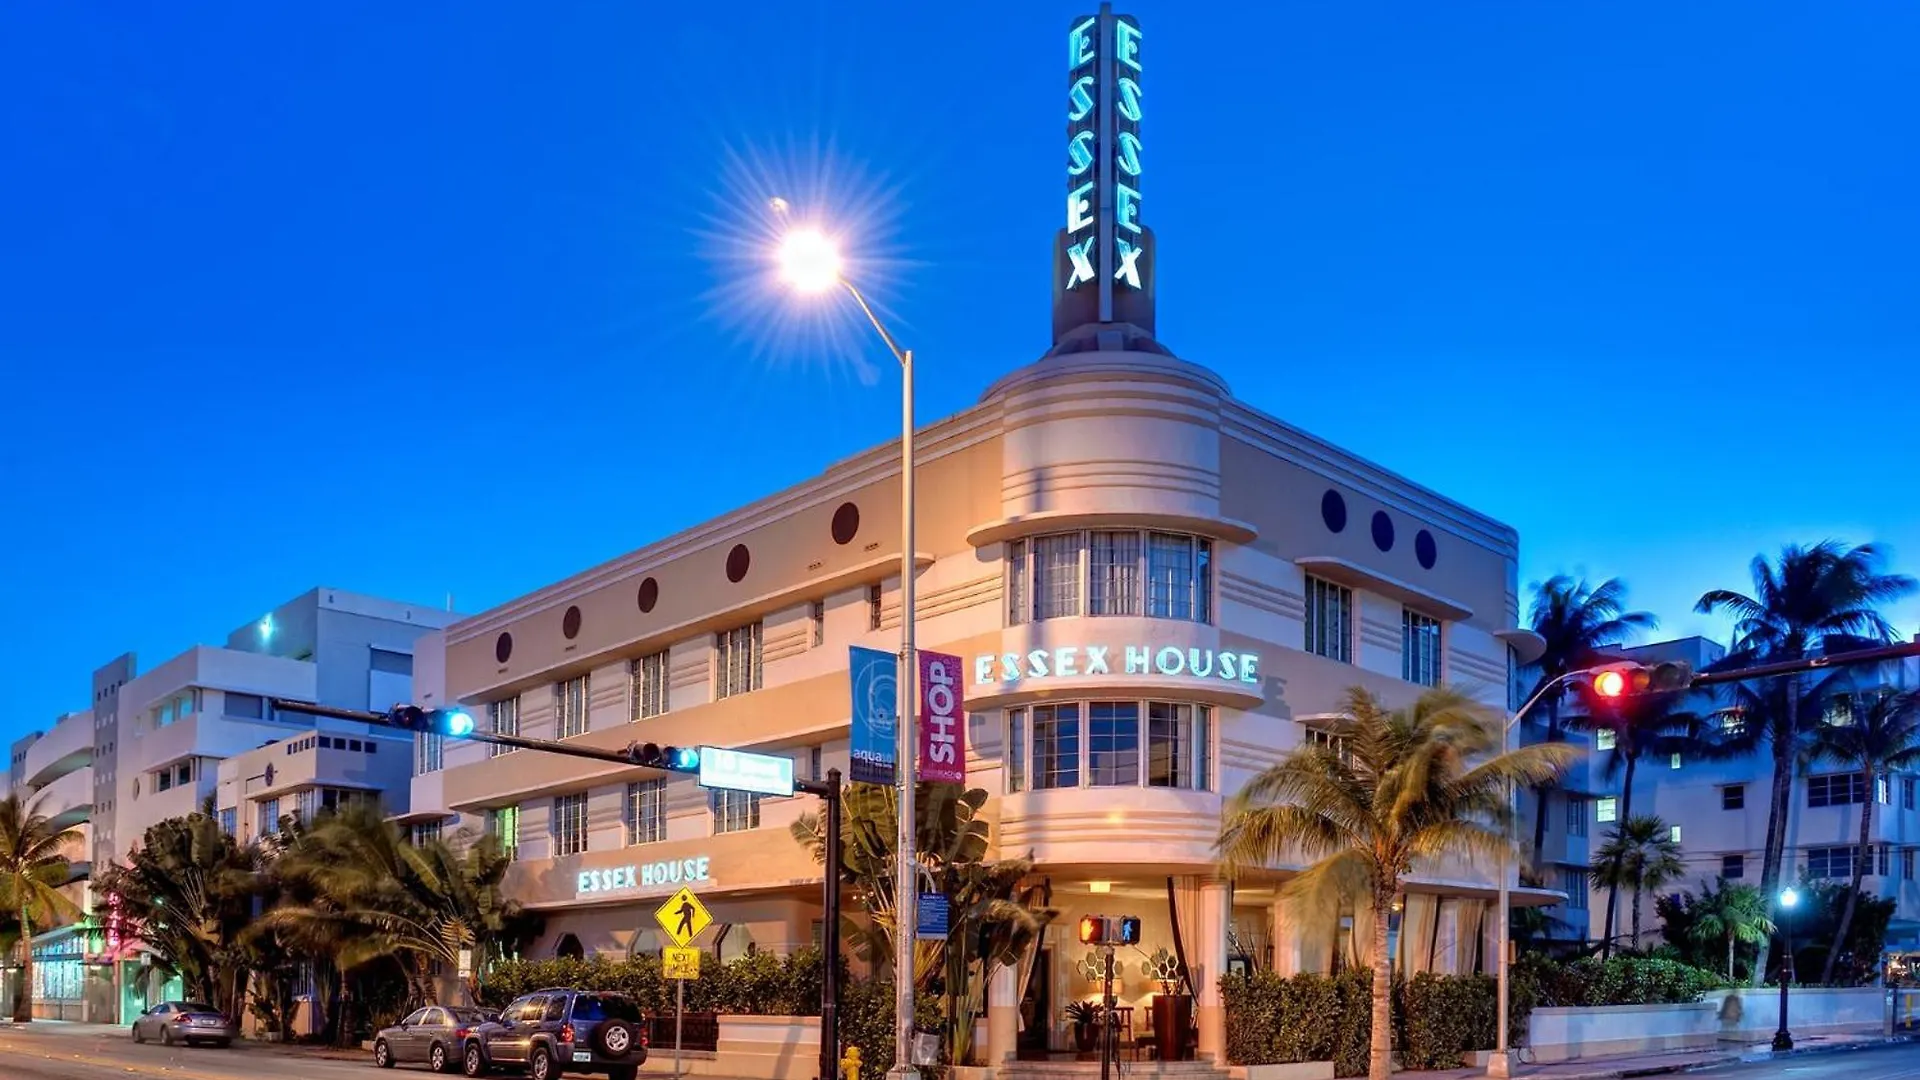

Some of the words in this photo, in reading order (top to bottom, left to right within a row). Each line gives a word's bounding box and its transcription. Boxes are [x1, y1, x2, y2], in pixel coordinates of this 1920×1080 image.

[1067, 17, 1095, 289] ESSEX
[1114, 19, 1143, 289] ESSEX
[929, 660, 956, 765] SHOP
[975, 646, 1109, 685] ESSEX
[1124, 645, 1260, 684] HOUSE
[577, 865, 637, 892] ESSEX
[642, 857, 710, 887] HOUSE
